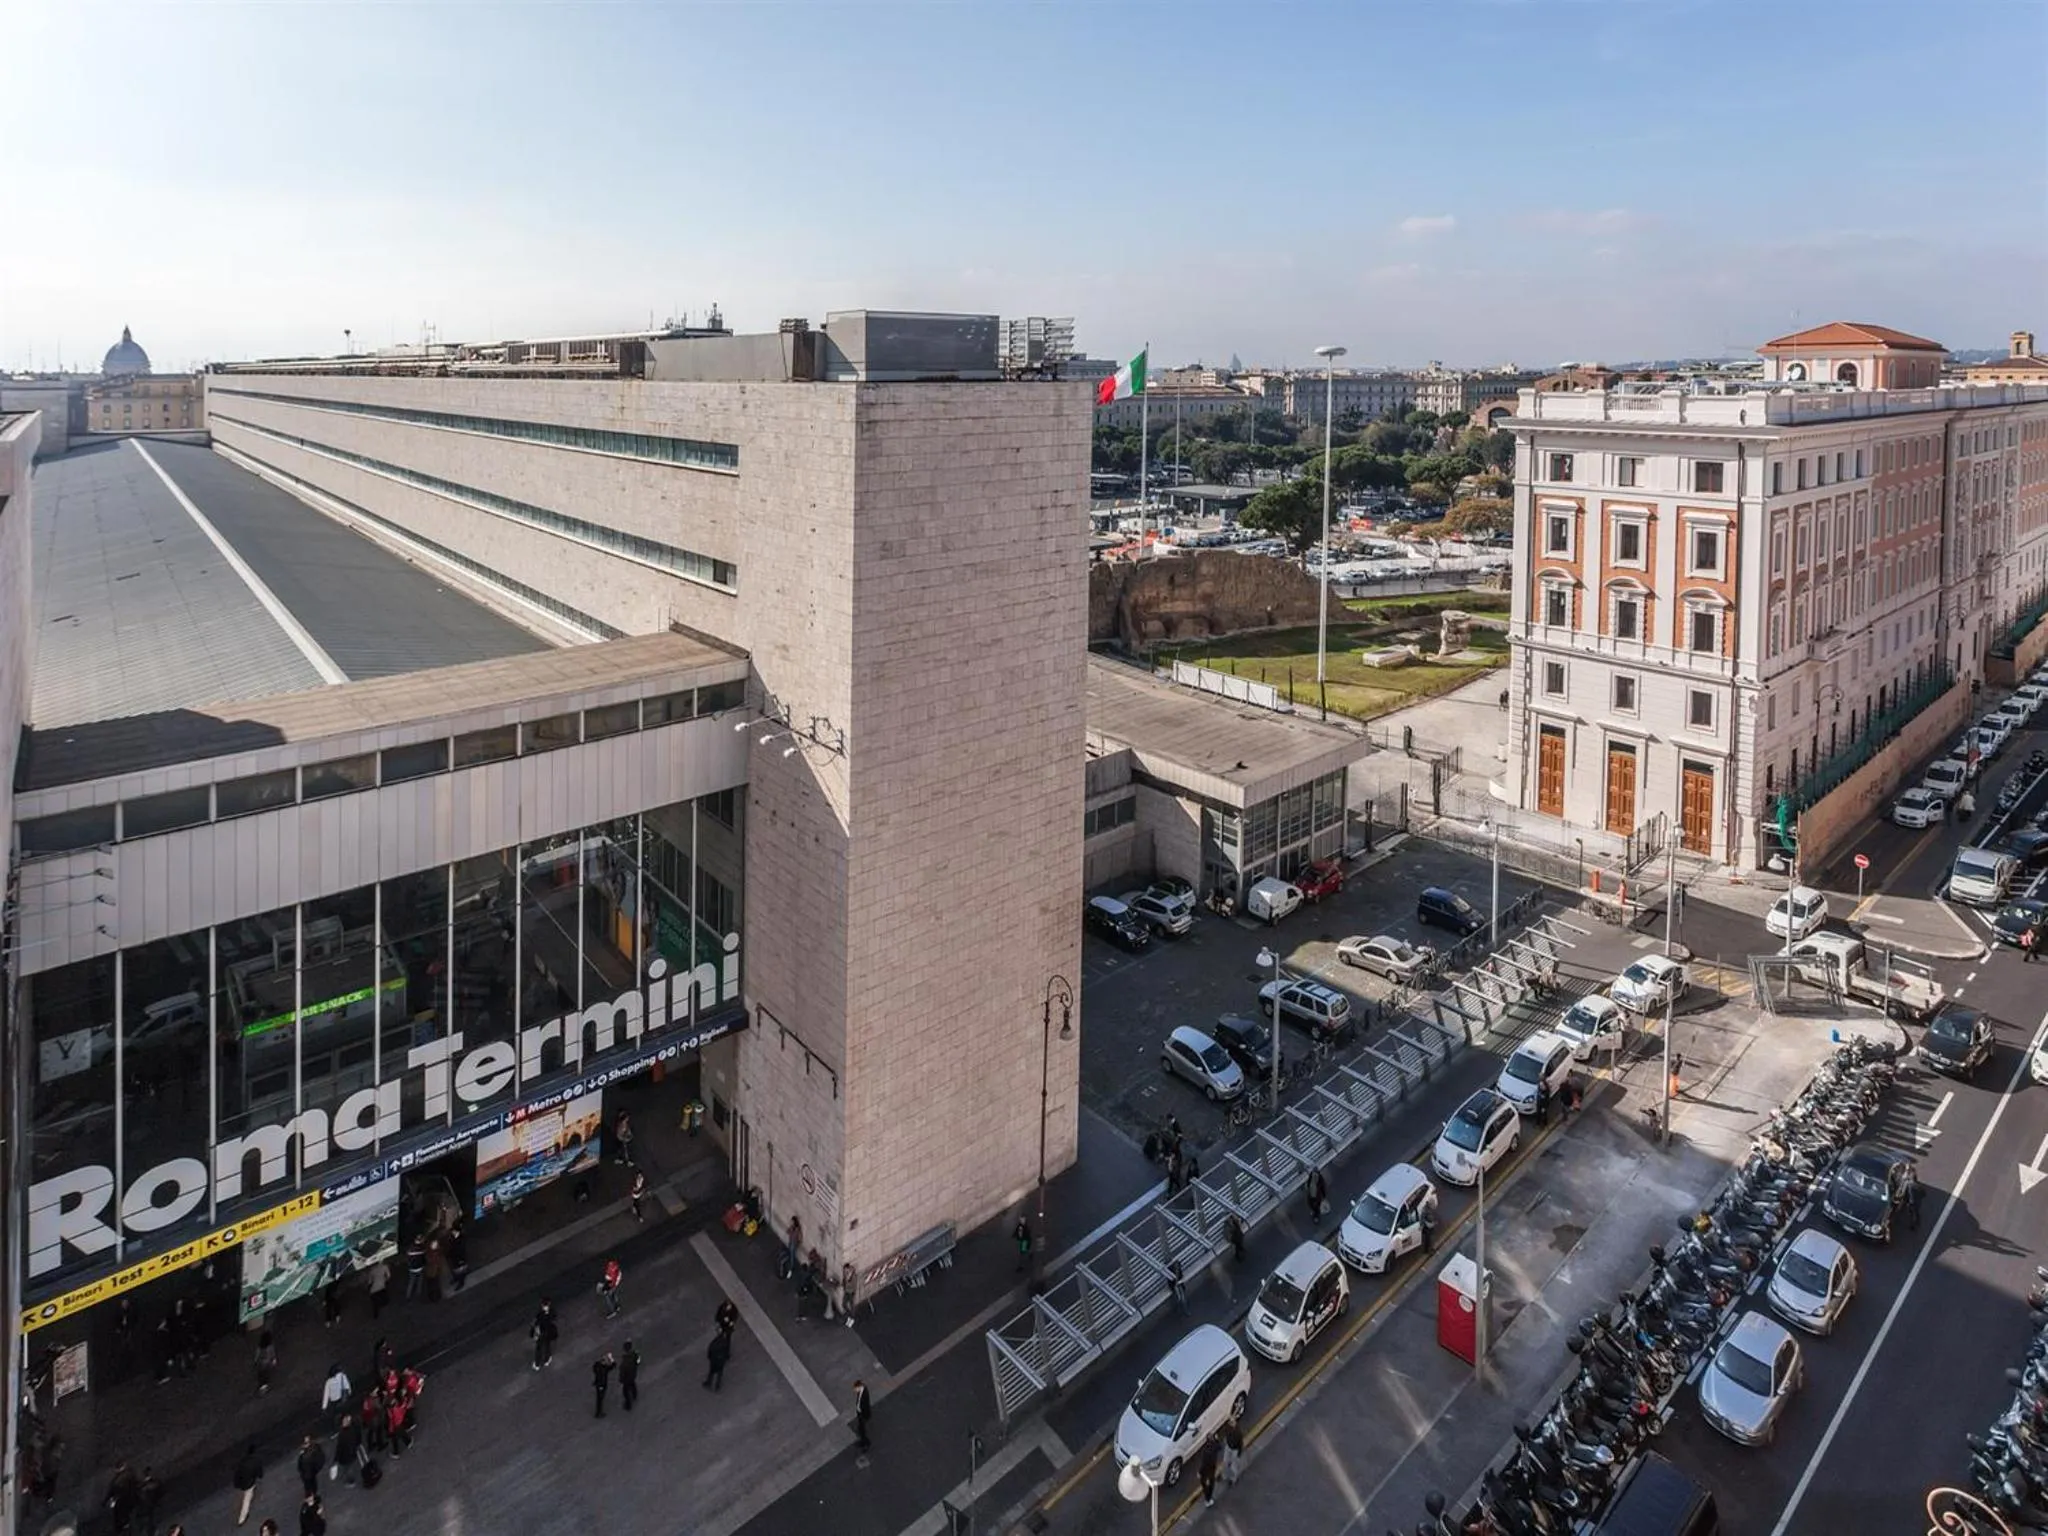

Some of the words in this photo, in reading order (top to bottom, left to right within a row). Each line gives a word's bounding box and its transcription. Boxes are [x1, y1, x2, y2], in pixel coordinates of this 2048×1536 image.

[608, 1055, 656, 1081] Shopping
[528, 1095, 562, 1114] Metro
[241, 1212, 275, 1231] Binari
[63, 1283, 103, 1306] Binari
[111, 1268, 144, 1288] 1est
[160, 1246, 194, 1268] 2est
